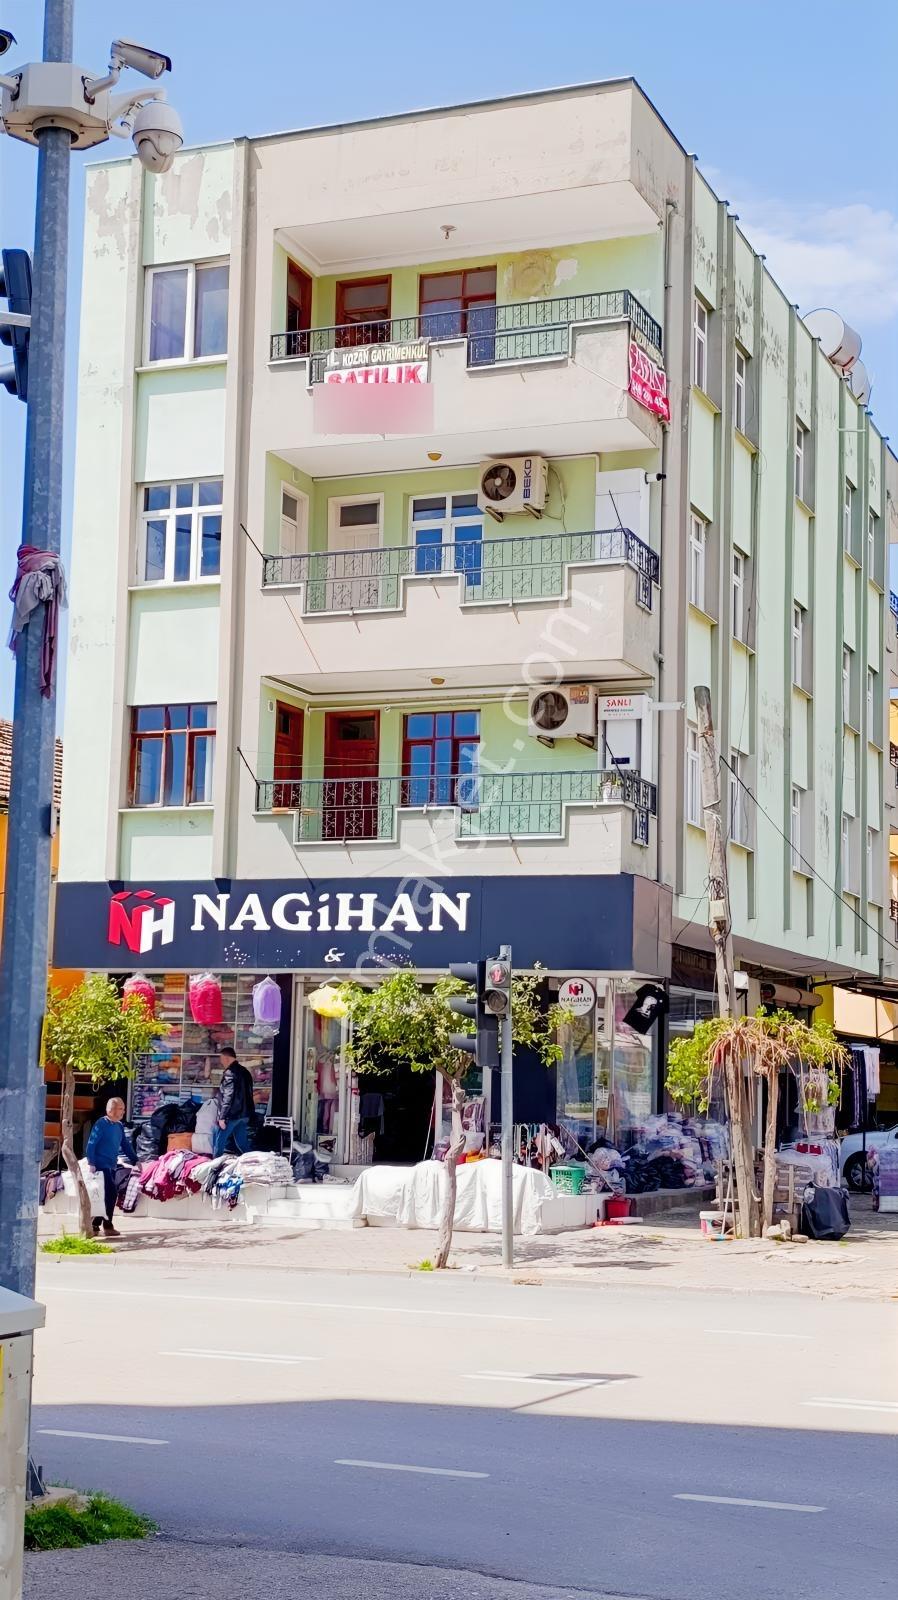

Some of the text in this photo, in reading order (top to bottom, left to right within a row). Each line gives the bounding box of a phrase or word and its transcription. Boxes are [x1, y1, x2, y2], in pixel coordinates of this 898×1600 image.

[342, 351, 369, 366] KOZAN
[523, 459, 531, 499] BEKO
[108, 890, 175, 954] NH
[324, 947, 345, 963] &
